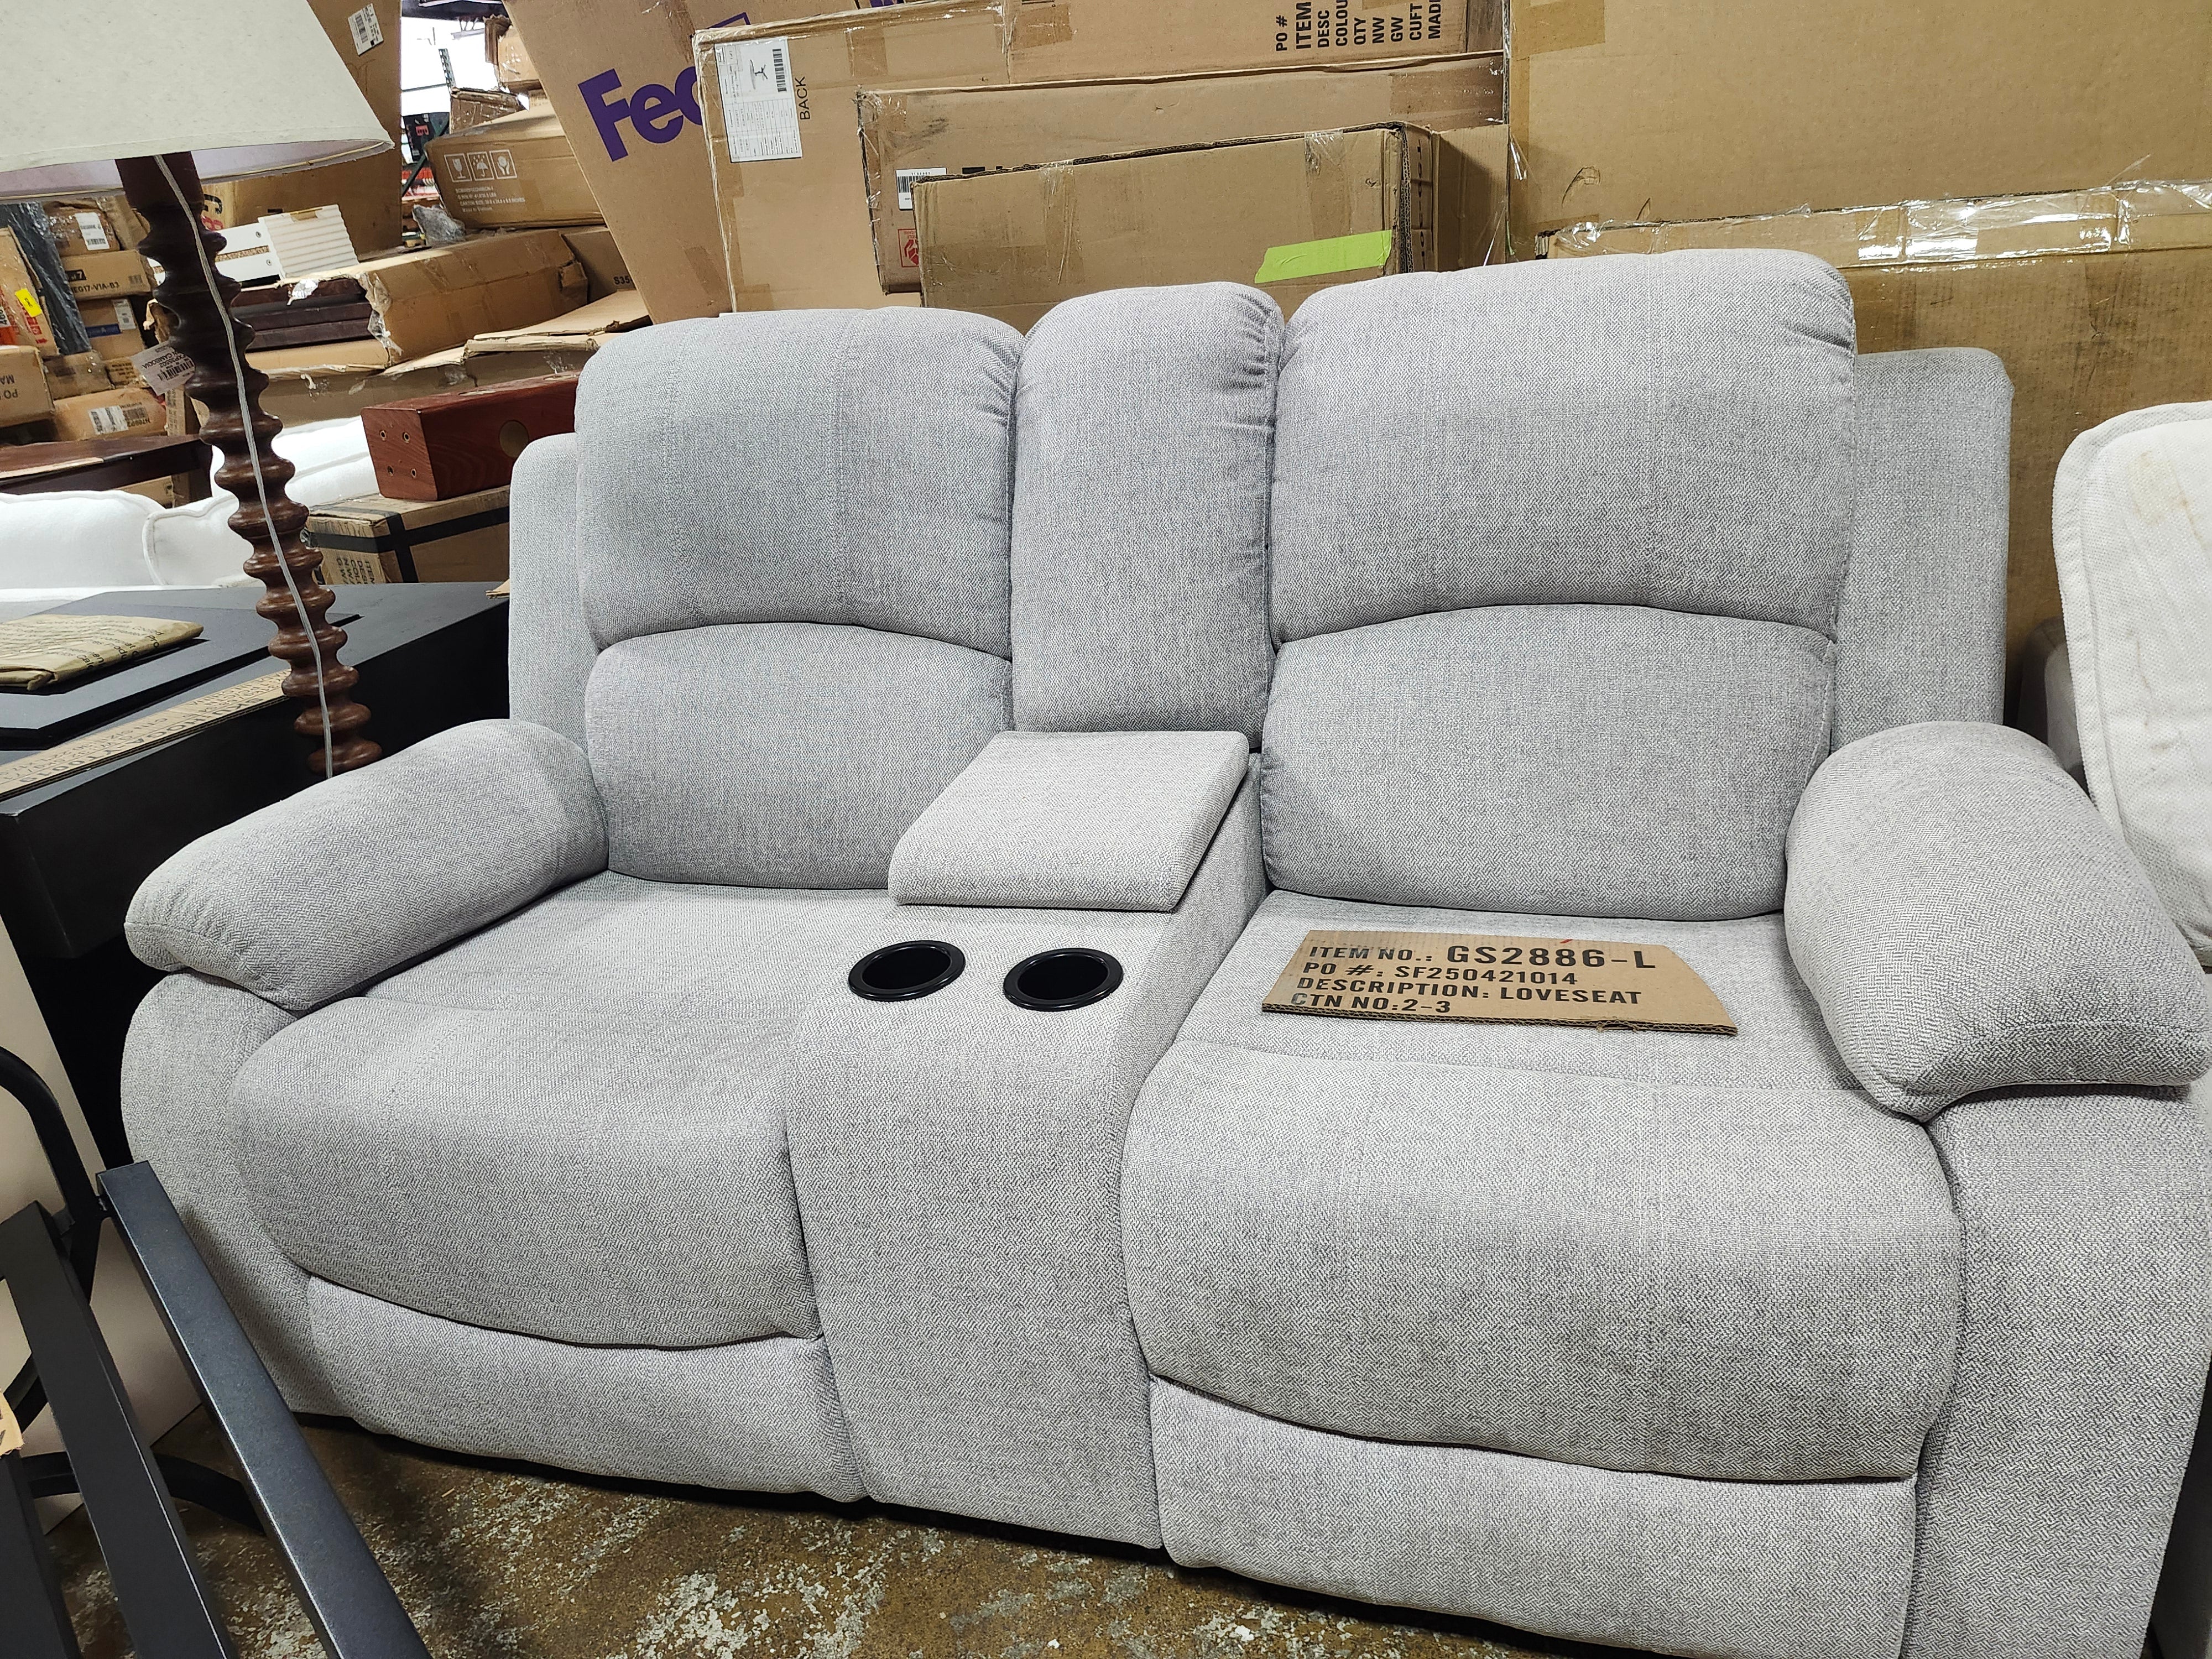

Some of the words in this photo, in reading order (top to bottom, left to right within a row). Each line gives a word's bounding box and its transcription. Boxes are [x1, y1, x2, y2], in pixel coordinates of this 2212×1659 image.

[1276, 14, 1287, 28] #
[1296, 2, 1311, 49] ITEM
[1317, 10, 1329, 48] DESC
[1354, 17, 1366, 45] QTY
[1372, 17, 1384, 44] NW
[1391, 17, 1403, 42] GW
[1409, 3, 1422, 40] CUFT
[1428, 0, 1441, 39] MAD
[1276, 32, 1287, 51] PO
[795, 76, 811, 120] BACK
[1309, 946, 1371, 961] ITEM
[1378, 948, 1433, 962] NO.:
[1447, 945, 1656, 969] GS2886-L
[1303, 962, 1337, 974] PO
[1345, 964, 1384, 977] #:
[1395, 966, 1578, 985] SF250421014
[1291, 992, 1343, 1007] CTN
[1352, 995, 1451, 1013] NO:2-3
[1297, 977, 1489, 999] DESCRIPTION:
[1500, 987, 1641, 1004] LOVESEAT
